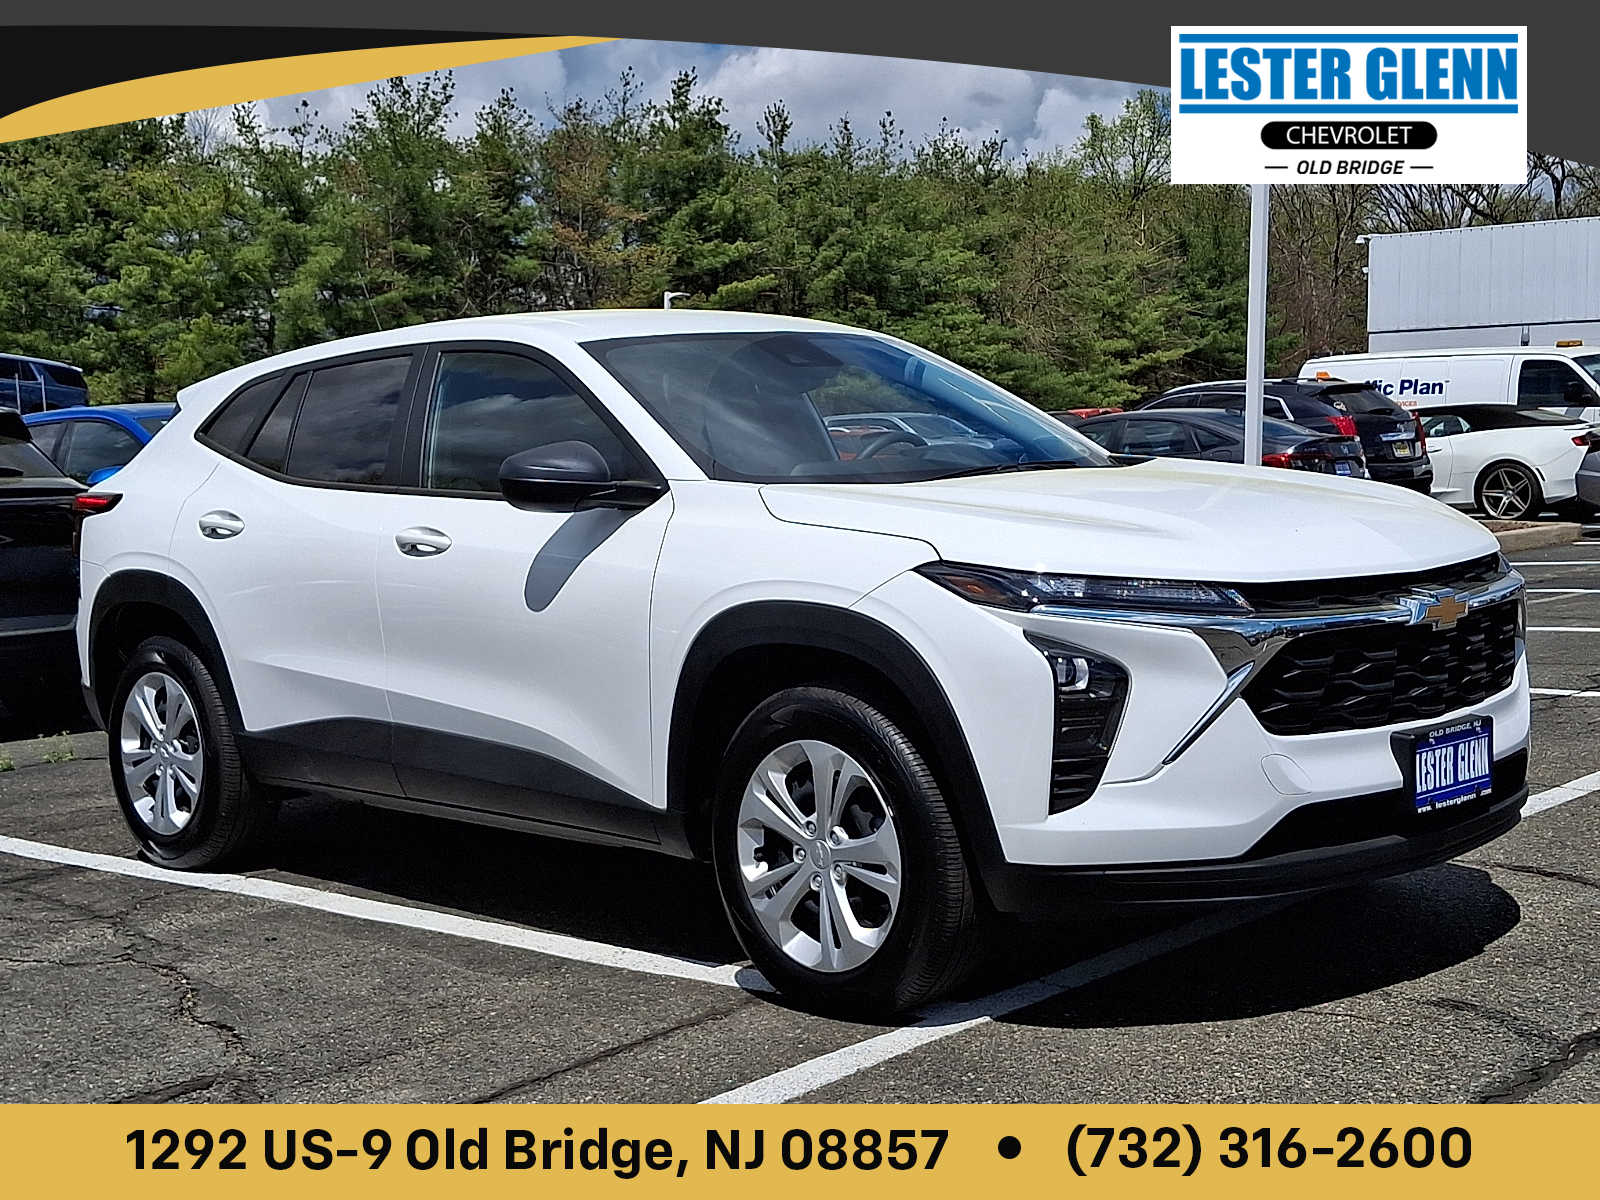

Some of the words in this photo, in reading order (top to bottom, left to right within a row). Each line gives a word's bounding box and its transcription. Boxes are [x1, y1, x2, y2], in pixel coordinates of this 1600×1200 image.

[1364, 380, 1394, 395] ic
[1399, 379, 1444, 395] Plan
[1473, 719, 1482, 727] NJ
[1416, 746, 1454, 793] LESTER
[1458, 737, 1489, 782] GLENN
[1435, 793, 1477, 809] lesterglenn
